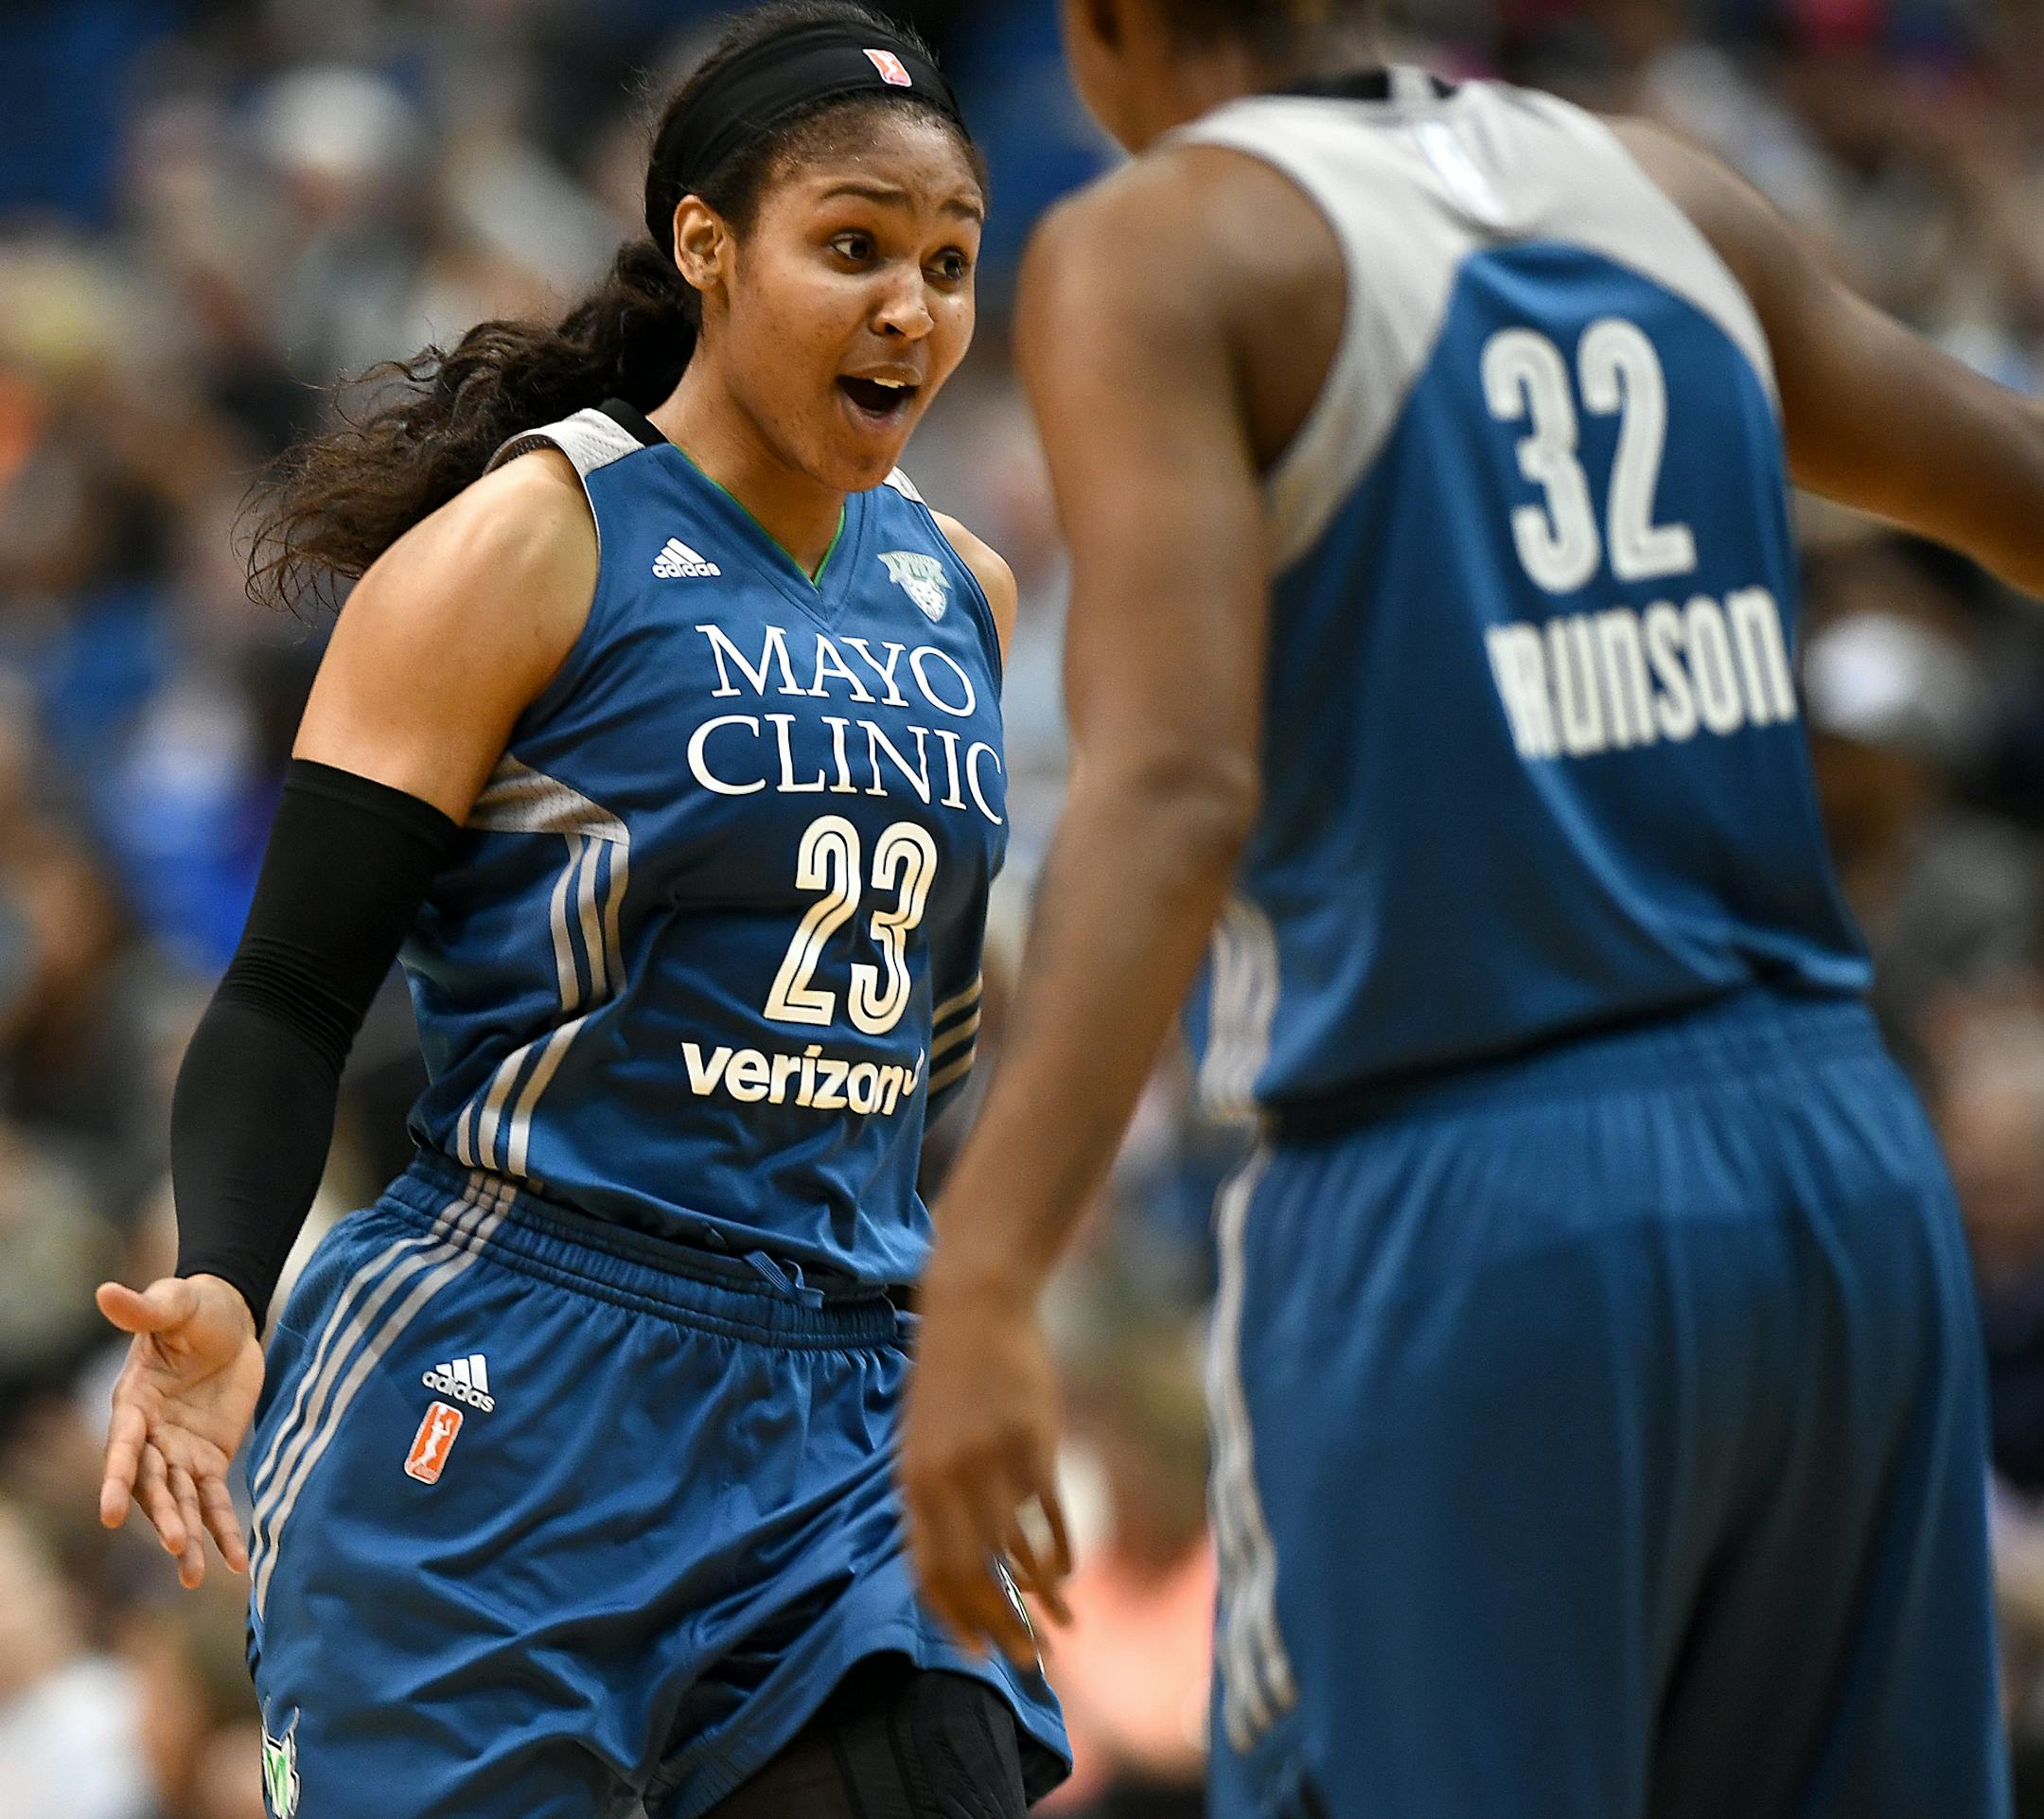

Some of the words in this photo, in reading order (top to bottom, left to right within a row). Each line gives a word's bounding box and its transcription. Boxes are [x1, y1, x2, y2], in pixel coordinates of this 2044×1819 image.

[1480, 316, 1698, 594] 32
[651, 561, 722, 579] adidas
[695, 624, 977, 717] MAYO
[686, 714, 1003, 826] CLINIC
[763, 814, 938, 1035] 23
[680, 1041, 904, 1116] verizon
[422, 1370, 496, 1413] adidas
